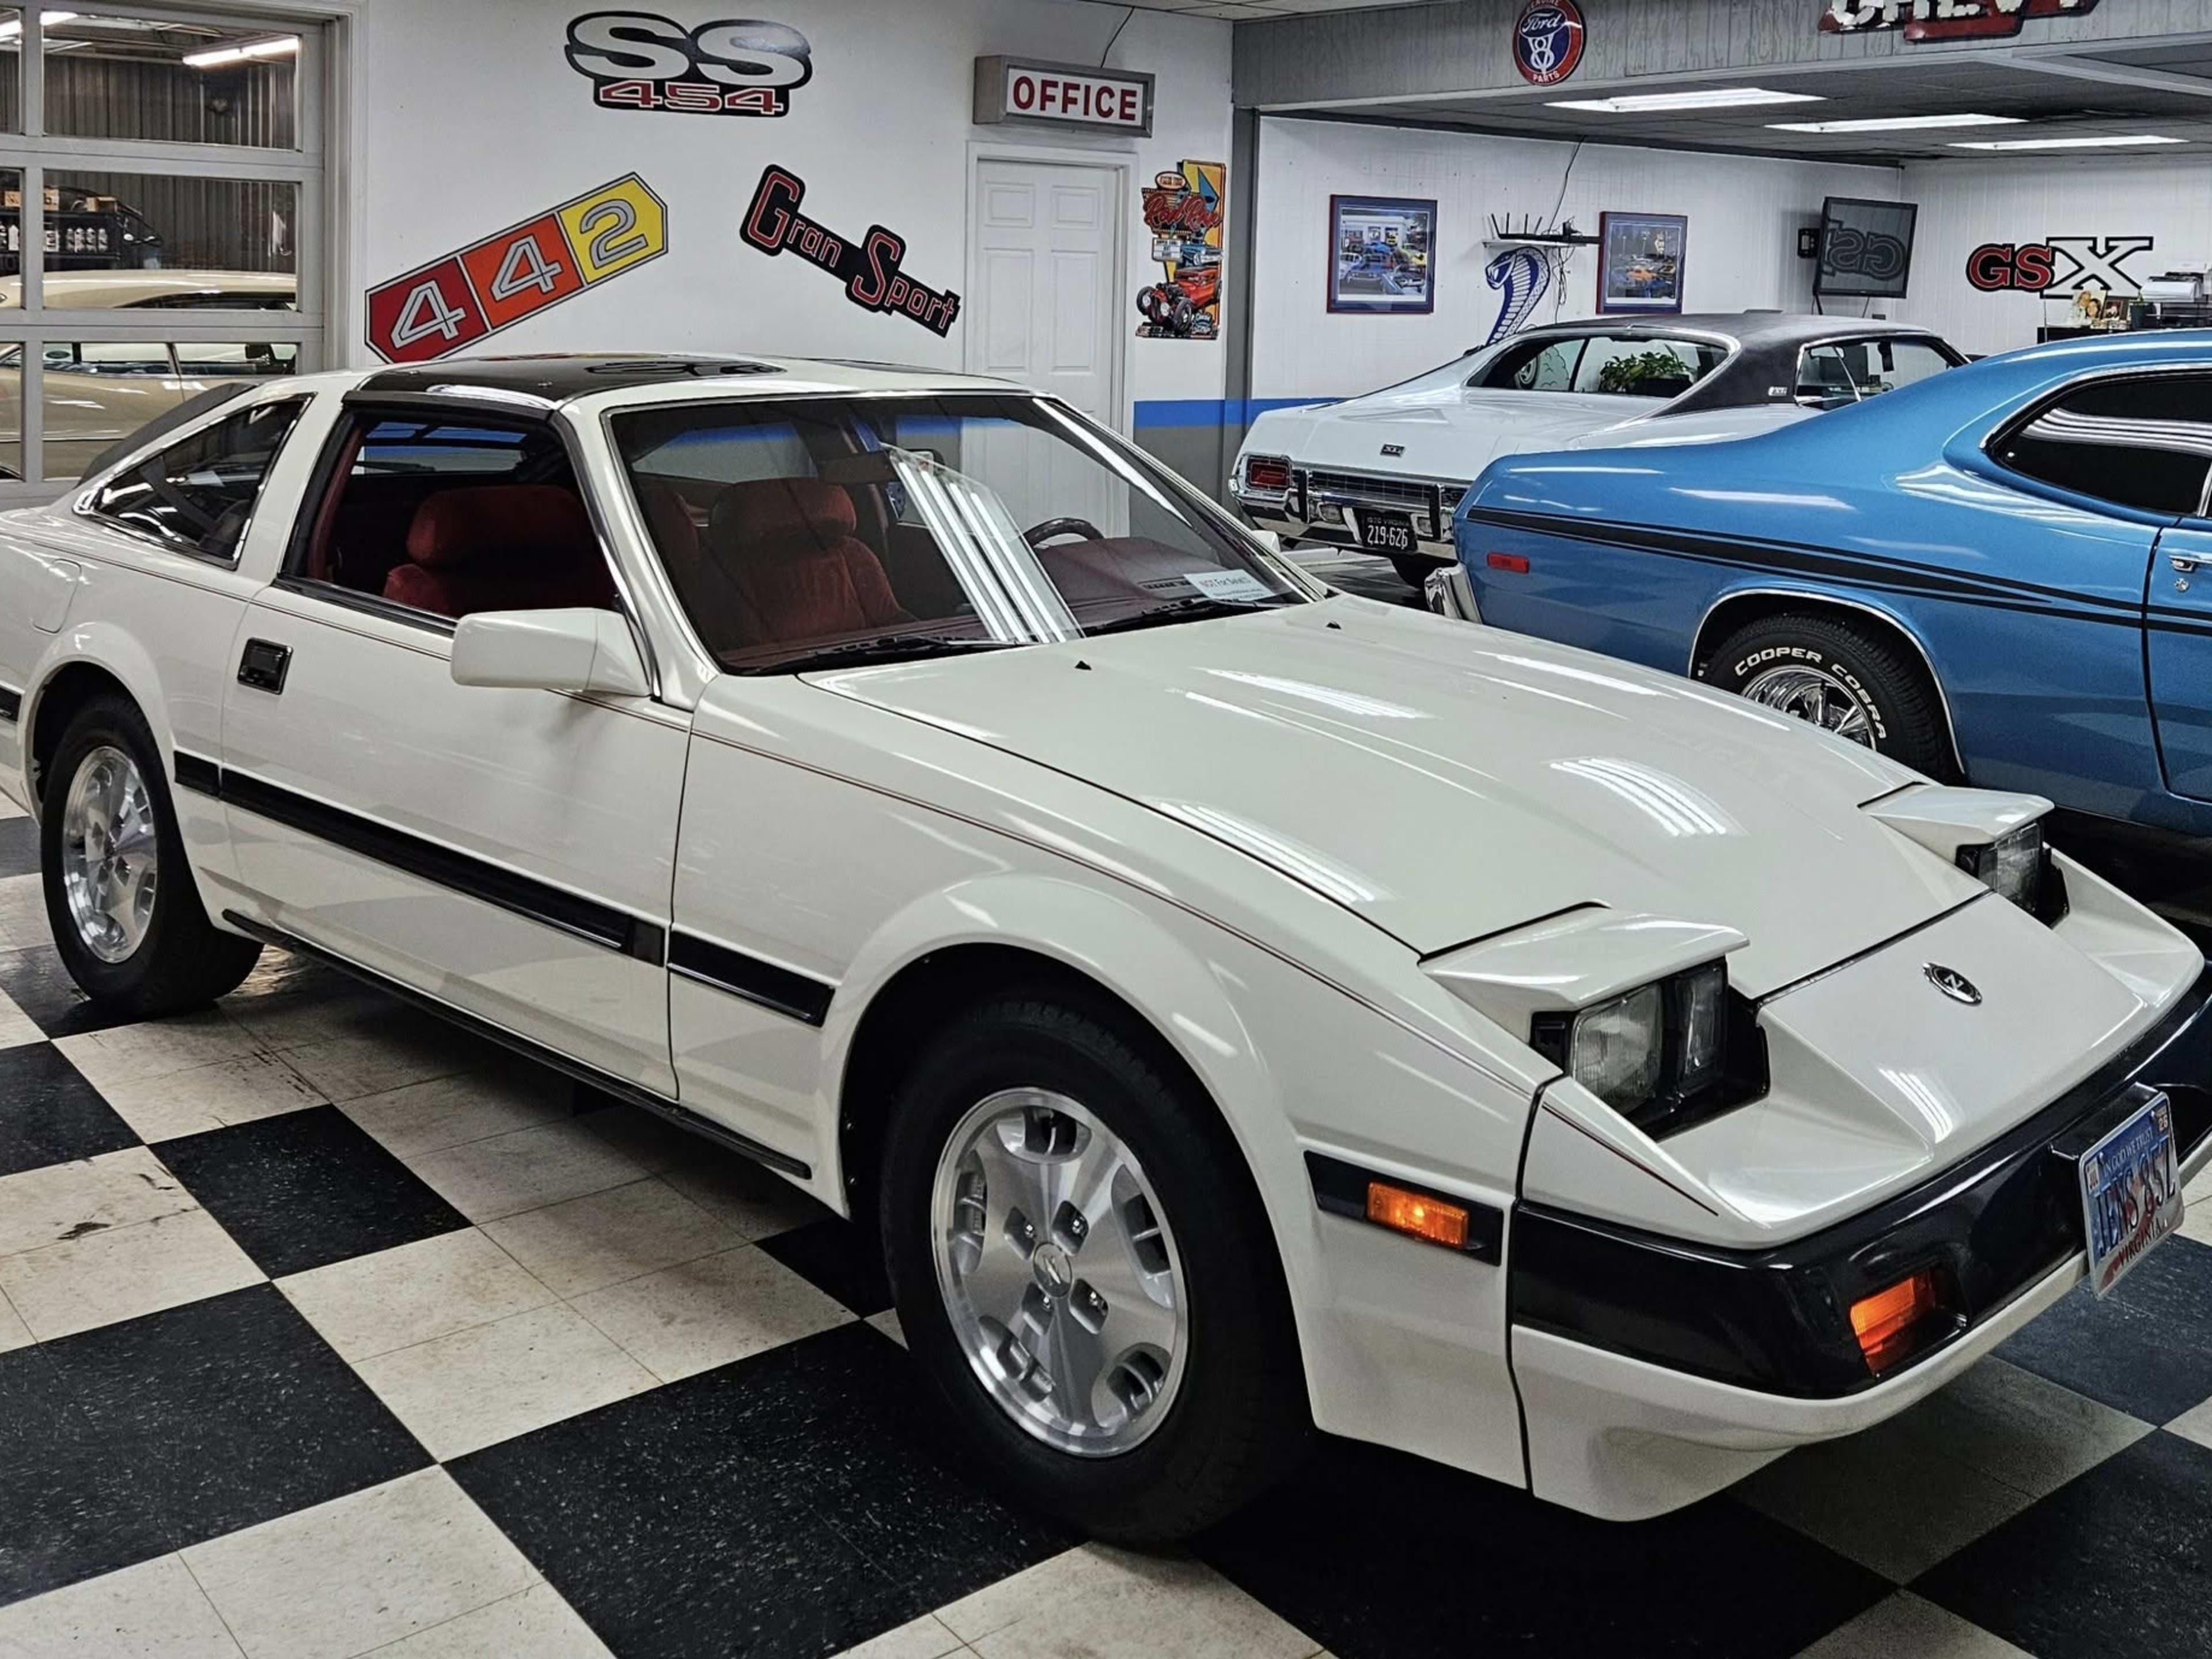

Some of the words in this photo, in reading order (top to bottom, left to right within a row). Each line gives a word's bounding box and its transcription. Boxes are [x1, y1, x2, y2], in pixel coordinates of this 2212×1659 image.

[1522, 13, 1562, 33] Ford
[570, 12, 812, 89] SS
[599, 79, 784, 115] 454
[1012, 75, 1138, 121] OFFICE
[1533, 71, 1560, 82] PARTS
[748, 171, 843, 268] Gran
[852, 231, 955, 330] Sport
[1965, 236, 2154, 299] GSX
[1734, 646, 1823, 676] COOPER
[1831, 663, 1887, 739] COBRA
[2119, 1217, 2162, 1267] VIRGINIA
